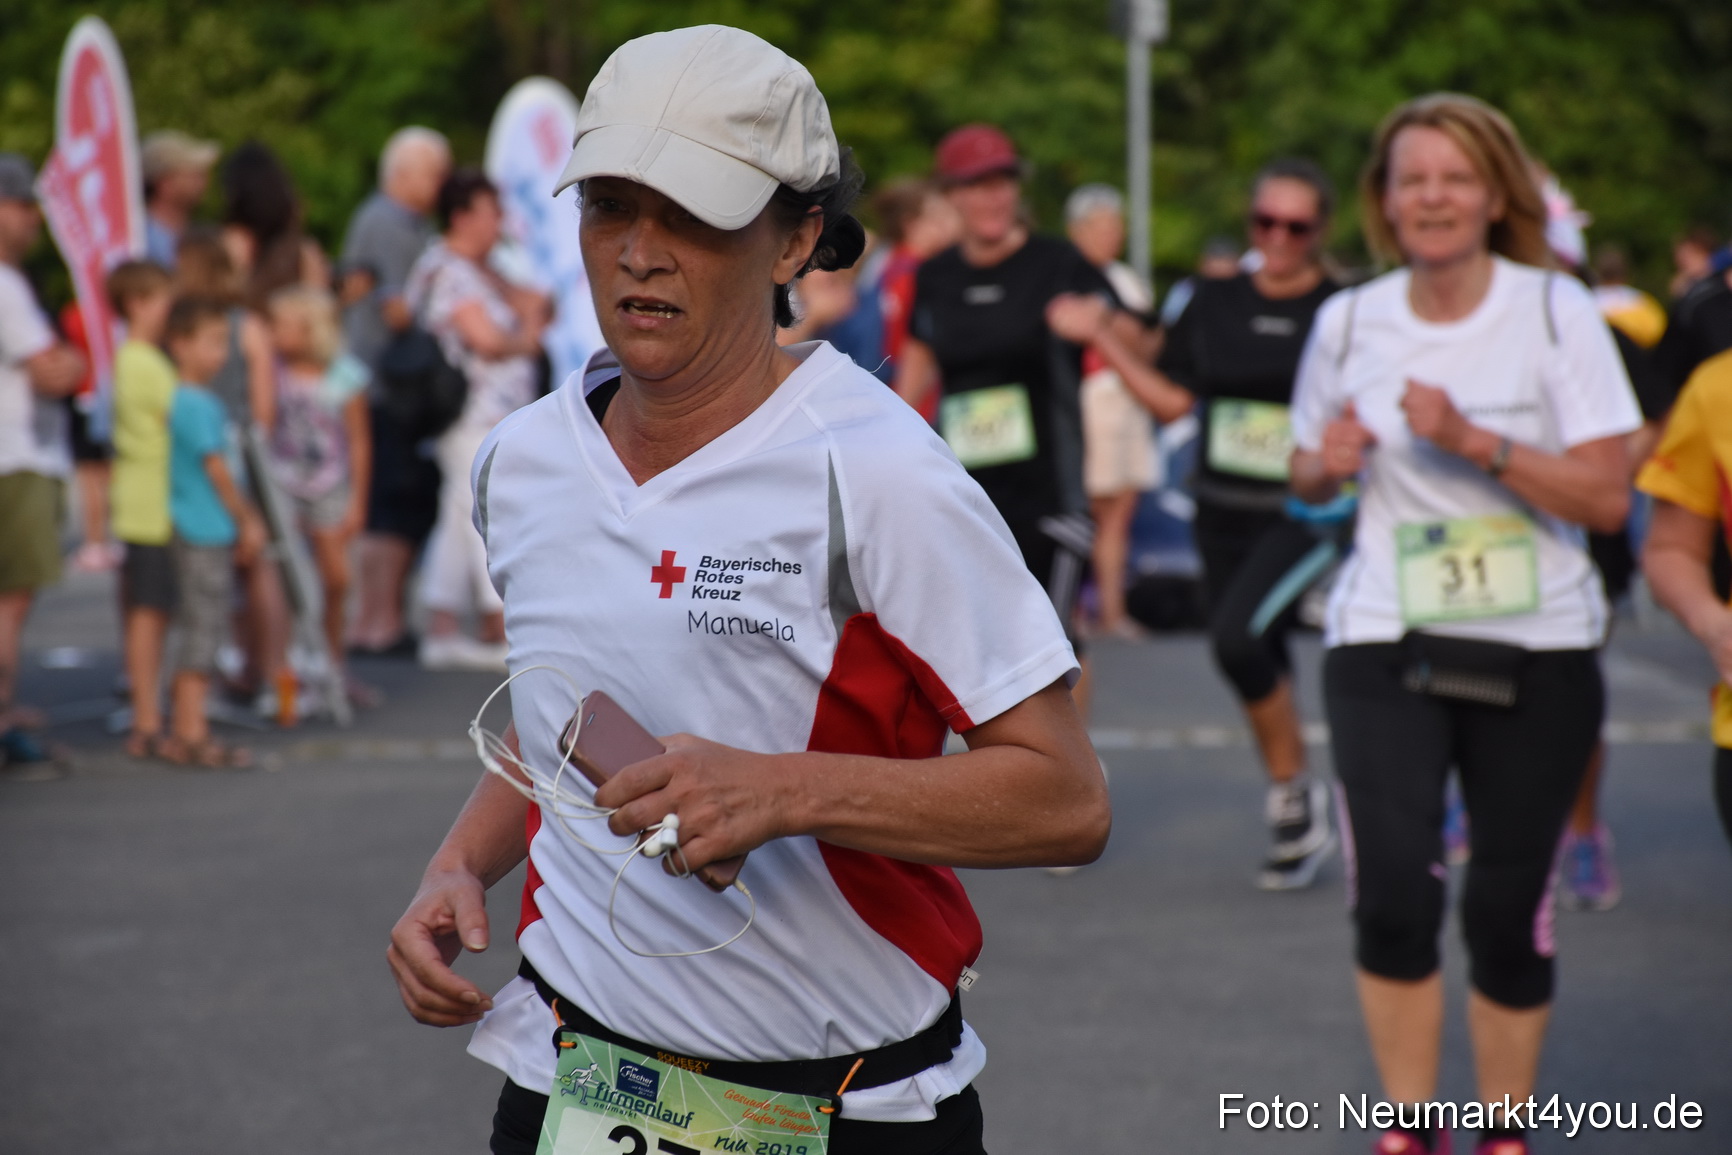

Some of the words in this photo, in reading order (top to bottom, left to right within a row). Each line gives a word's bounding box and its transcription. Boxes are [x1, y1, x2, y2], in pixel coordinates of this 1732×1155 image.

[700, 555, 802, 575] Bayerisches
[1440, 553, 1487, 596] 31
[694, 569, 744, 584] Rotes
[692, 585, 741, 601] Kreuz
[688, 610, 796, 643] Manuela
[657, 1051, 710, 1069] SQUEEZY
[626, 1069, 653, 1085] Fischer
[593, 1102, 638, 1119] neumarkt
[595, 1081, 695, 1129] firmenlauf
[724, 1089, 770, 1111] Gesunde
[773, 1104, 811, 1120] Firmen
[742, 1108, 776, 1125] laufen
[779, 1118, 820, 1136] länger!
[714, 1136, 748, 1153] run
[755, 1142, 808, 1155] 2019
